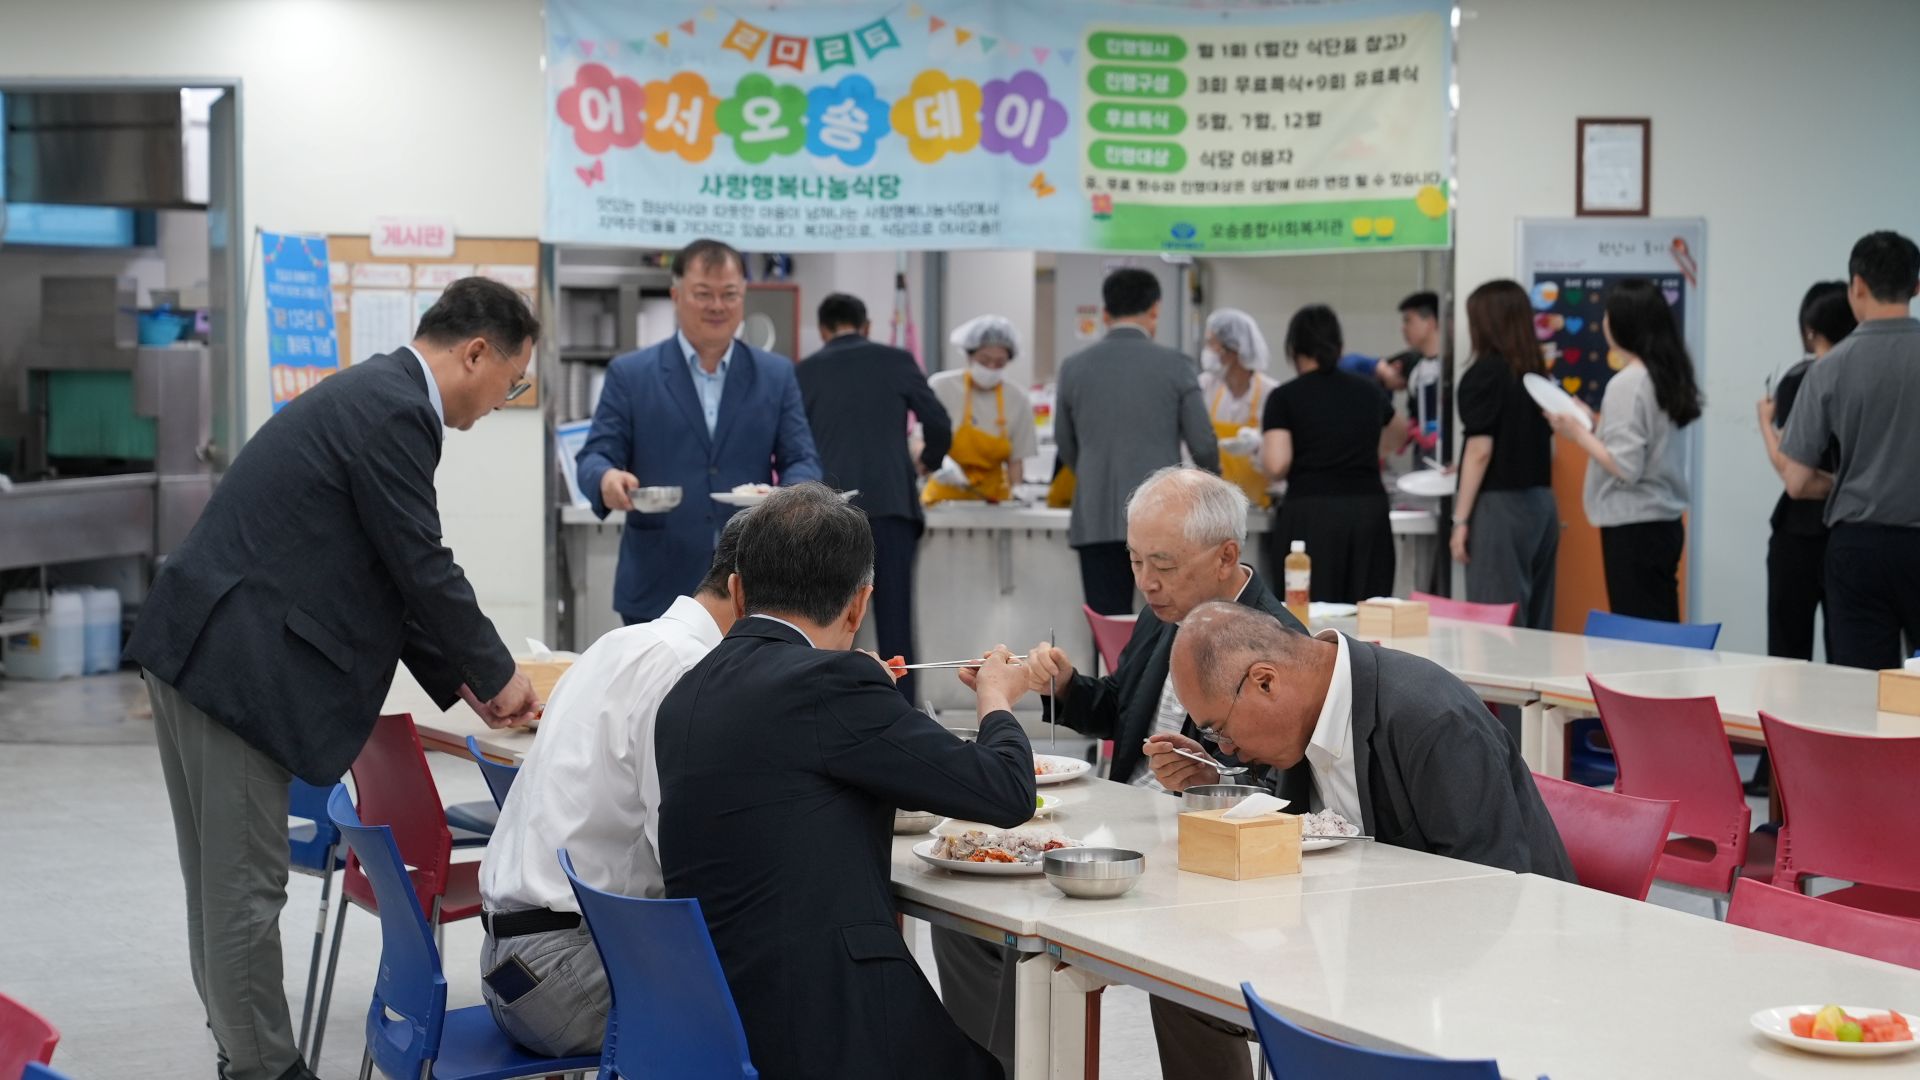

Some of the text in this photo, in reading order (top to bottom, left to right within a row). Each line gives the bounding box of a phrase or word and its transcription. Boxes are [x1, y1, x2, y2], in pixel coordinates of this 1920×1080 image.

[1198, 43, 1214, 59] 월
[1255, 41, 1299, 58] (월간
[1307, 37, 1358, 56] 식단표
[1366, 33, 1407, 53] 참고)
[1104, 71, 1170, 92] 진행구성
[1198, 76, 1227, 93] 3회
[1354, 65, 1419, 88] 유료특식
[1106, 109, 1170, 129] 무료특식
[1285, 111, 1322, 129] 12월
[1104, 146, 1294, 168] 진행대상 식당 이용자
[700, 174, 901, 201] 사랑행복나눔식당
[1211, 219, 1342, 240] 오송종합사회복지관
